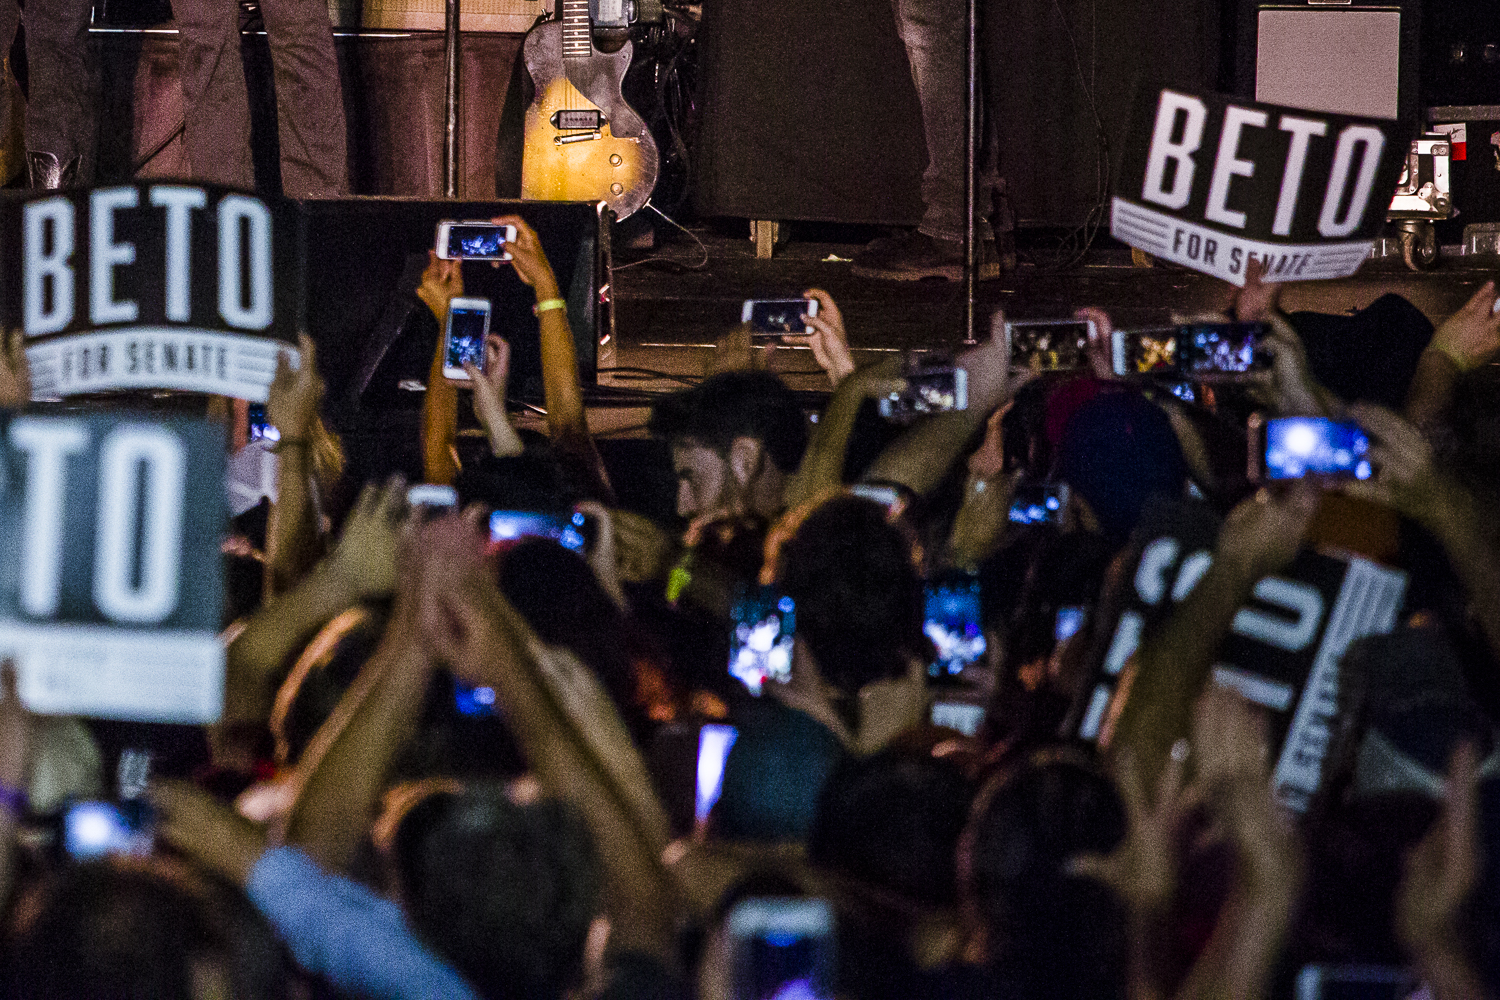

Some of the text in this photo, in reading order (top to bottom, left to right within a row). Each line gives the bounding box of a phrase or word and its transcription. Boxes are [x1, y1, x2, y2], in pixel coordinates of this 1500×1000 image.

[1141, 88, 1385, 237] BETO
[23, 185, 274, 337] BETO
[1173, 228, 1218, 266] FOR
[63, 341, 230, 381] FOR SENATE
